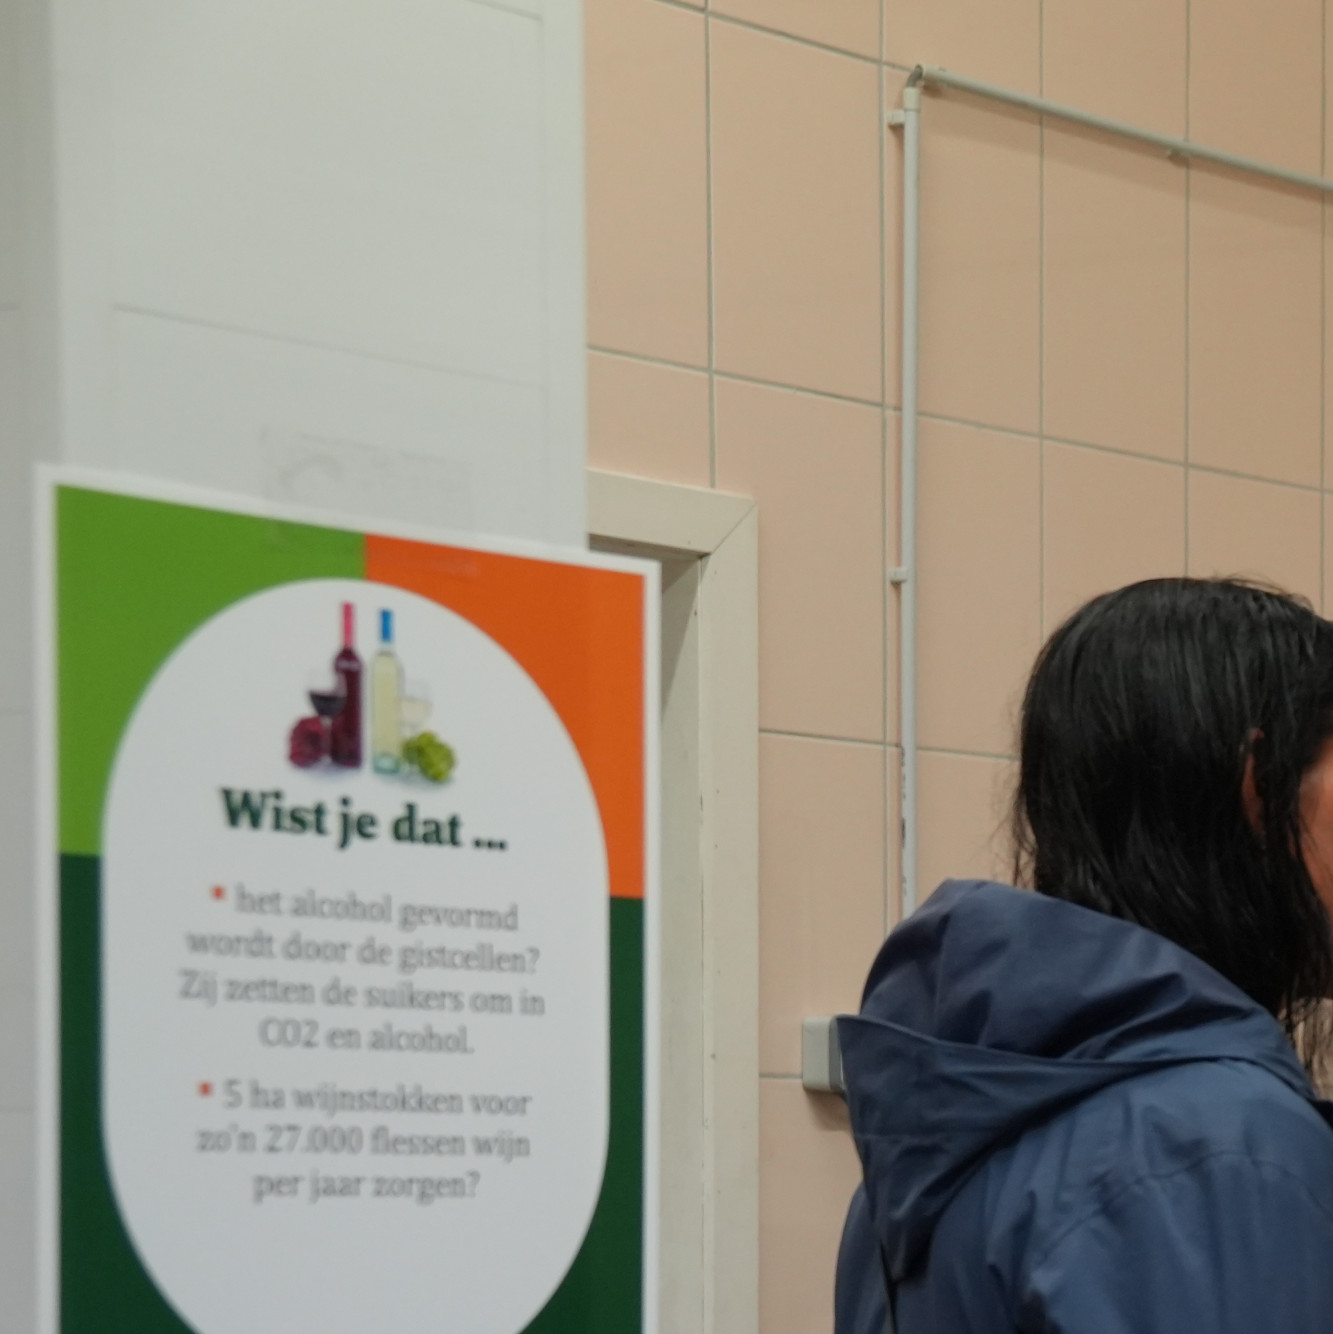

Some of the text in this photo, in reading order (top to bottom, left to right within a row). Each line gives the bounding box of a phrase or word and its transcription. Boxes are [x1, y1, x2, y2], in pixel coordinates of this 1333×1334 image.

[221, 786, 329, 838] Wist
[338, 797, 380, 851] je
[392, 803, 462, 848] dat
[235, 882, 518, 933] het alcohol gevormd
[186, 929, 541, 977] wordt door de gistcellen?
[178, 968, 546, 1017] Zij zetten de suikers om in
[258, 1018, 475, 1055] CO2 en alcohol.
[223, 1080, 532, 1118] 5 ha wijnstokken voor
[195, 1121, 530, 1163] zo'n 27.000 flessen wijn
[253, 1169, 480, 1206] per jaar zorgen?
